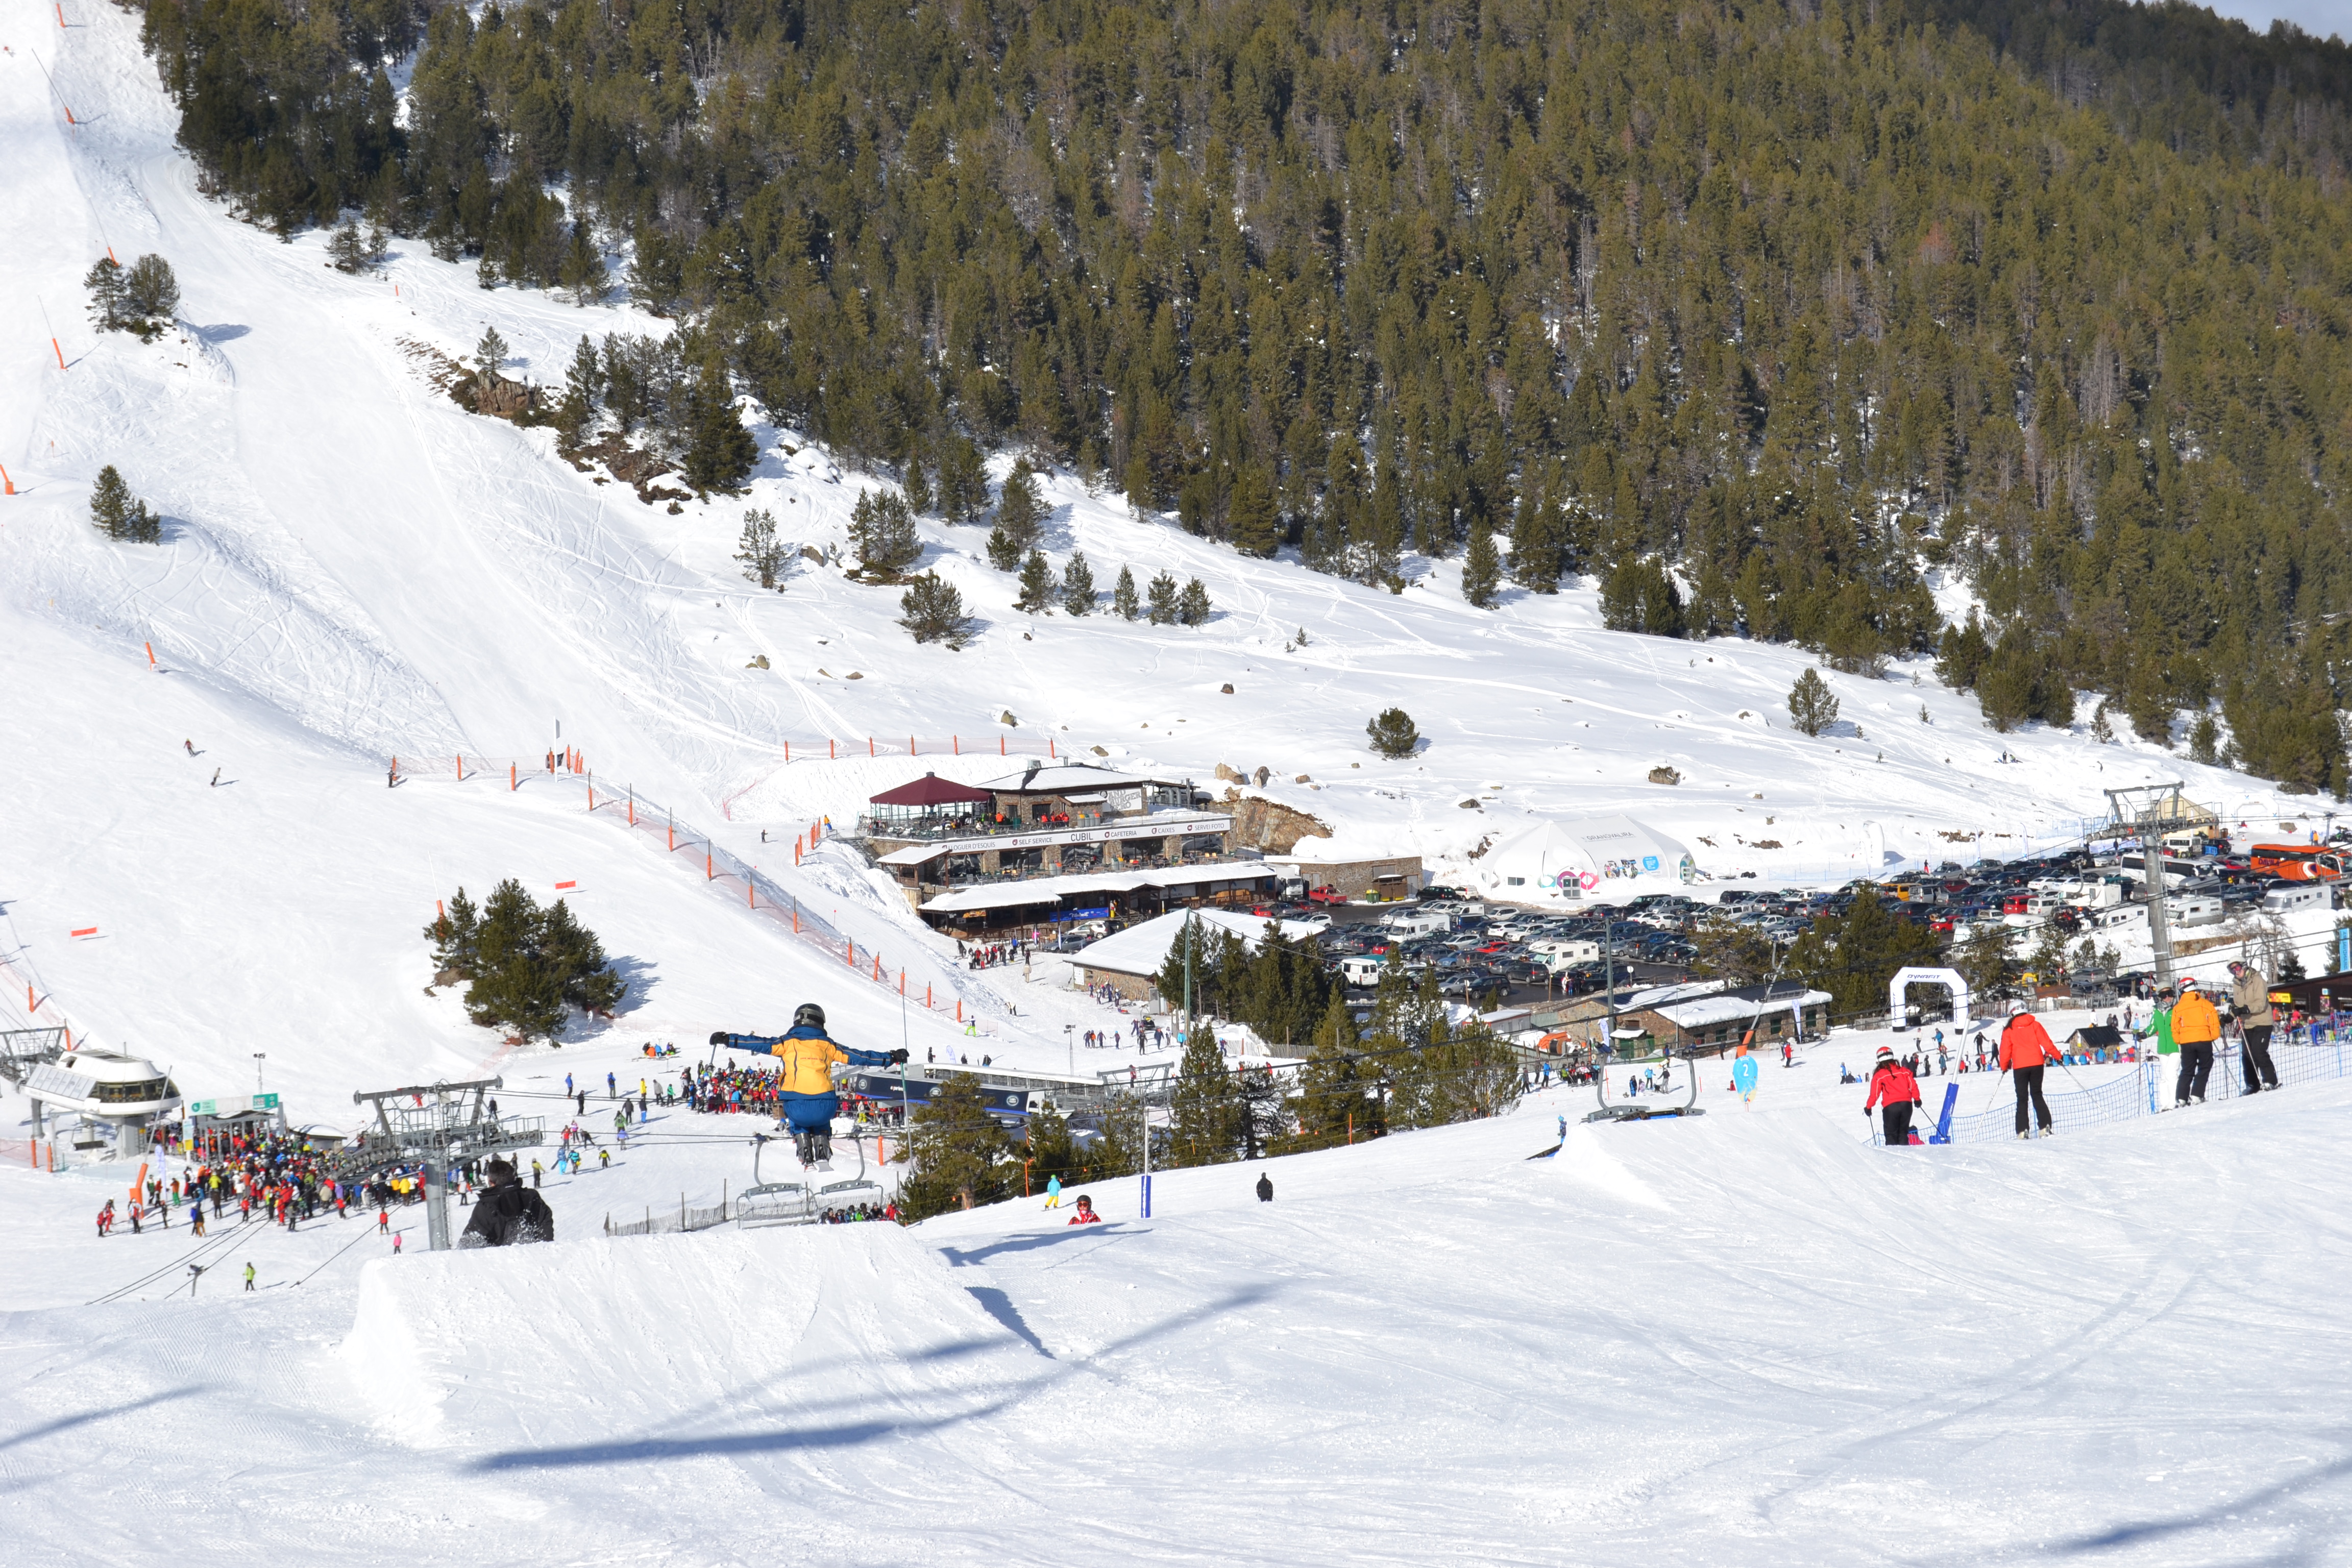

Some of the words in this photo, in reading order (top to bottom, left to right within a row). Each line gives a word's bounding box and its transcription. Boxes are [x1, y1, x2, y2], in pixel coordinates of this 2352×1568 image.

[1070, 832, 1093, 842] CUBIL
[1586, 832, 1634, 841] GRANDVALIRA
[1743, 1064, 1749, 1077] 2
